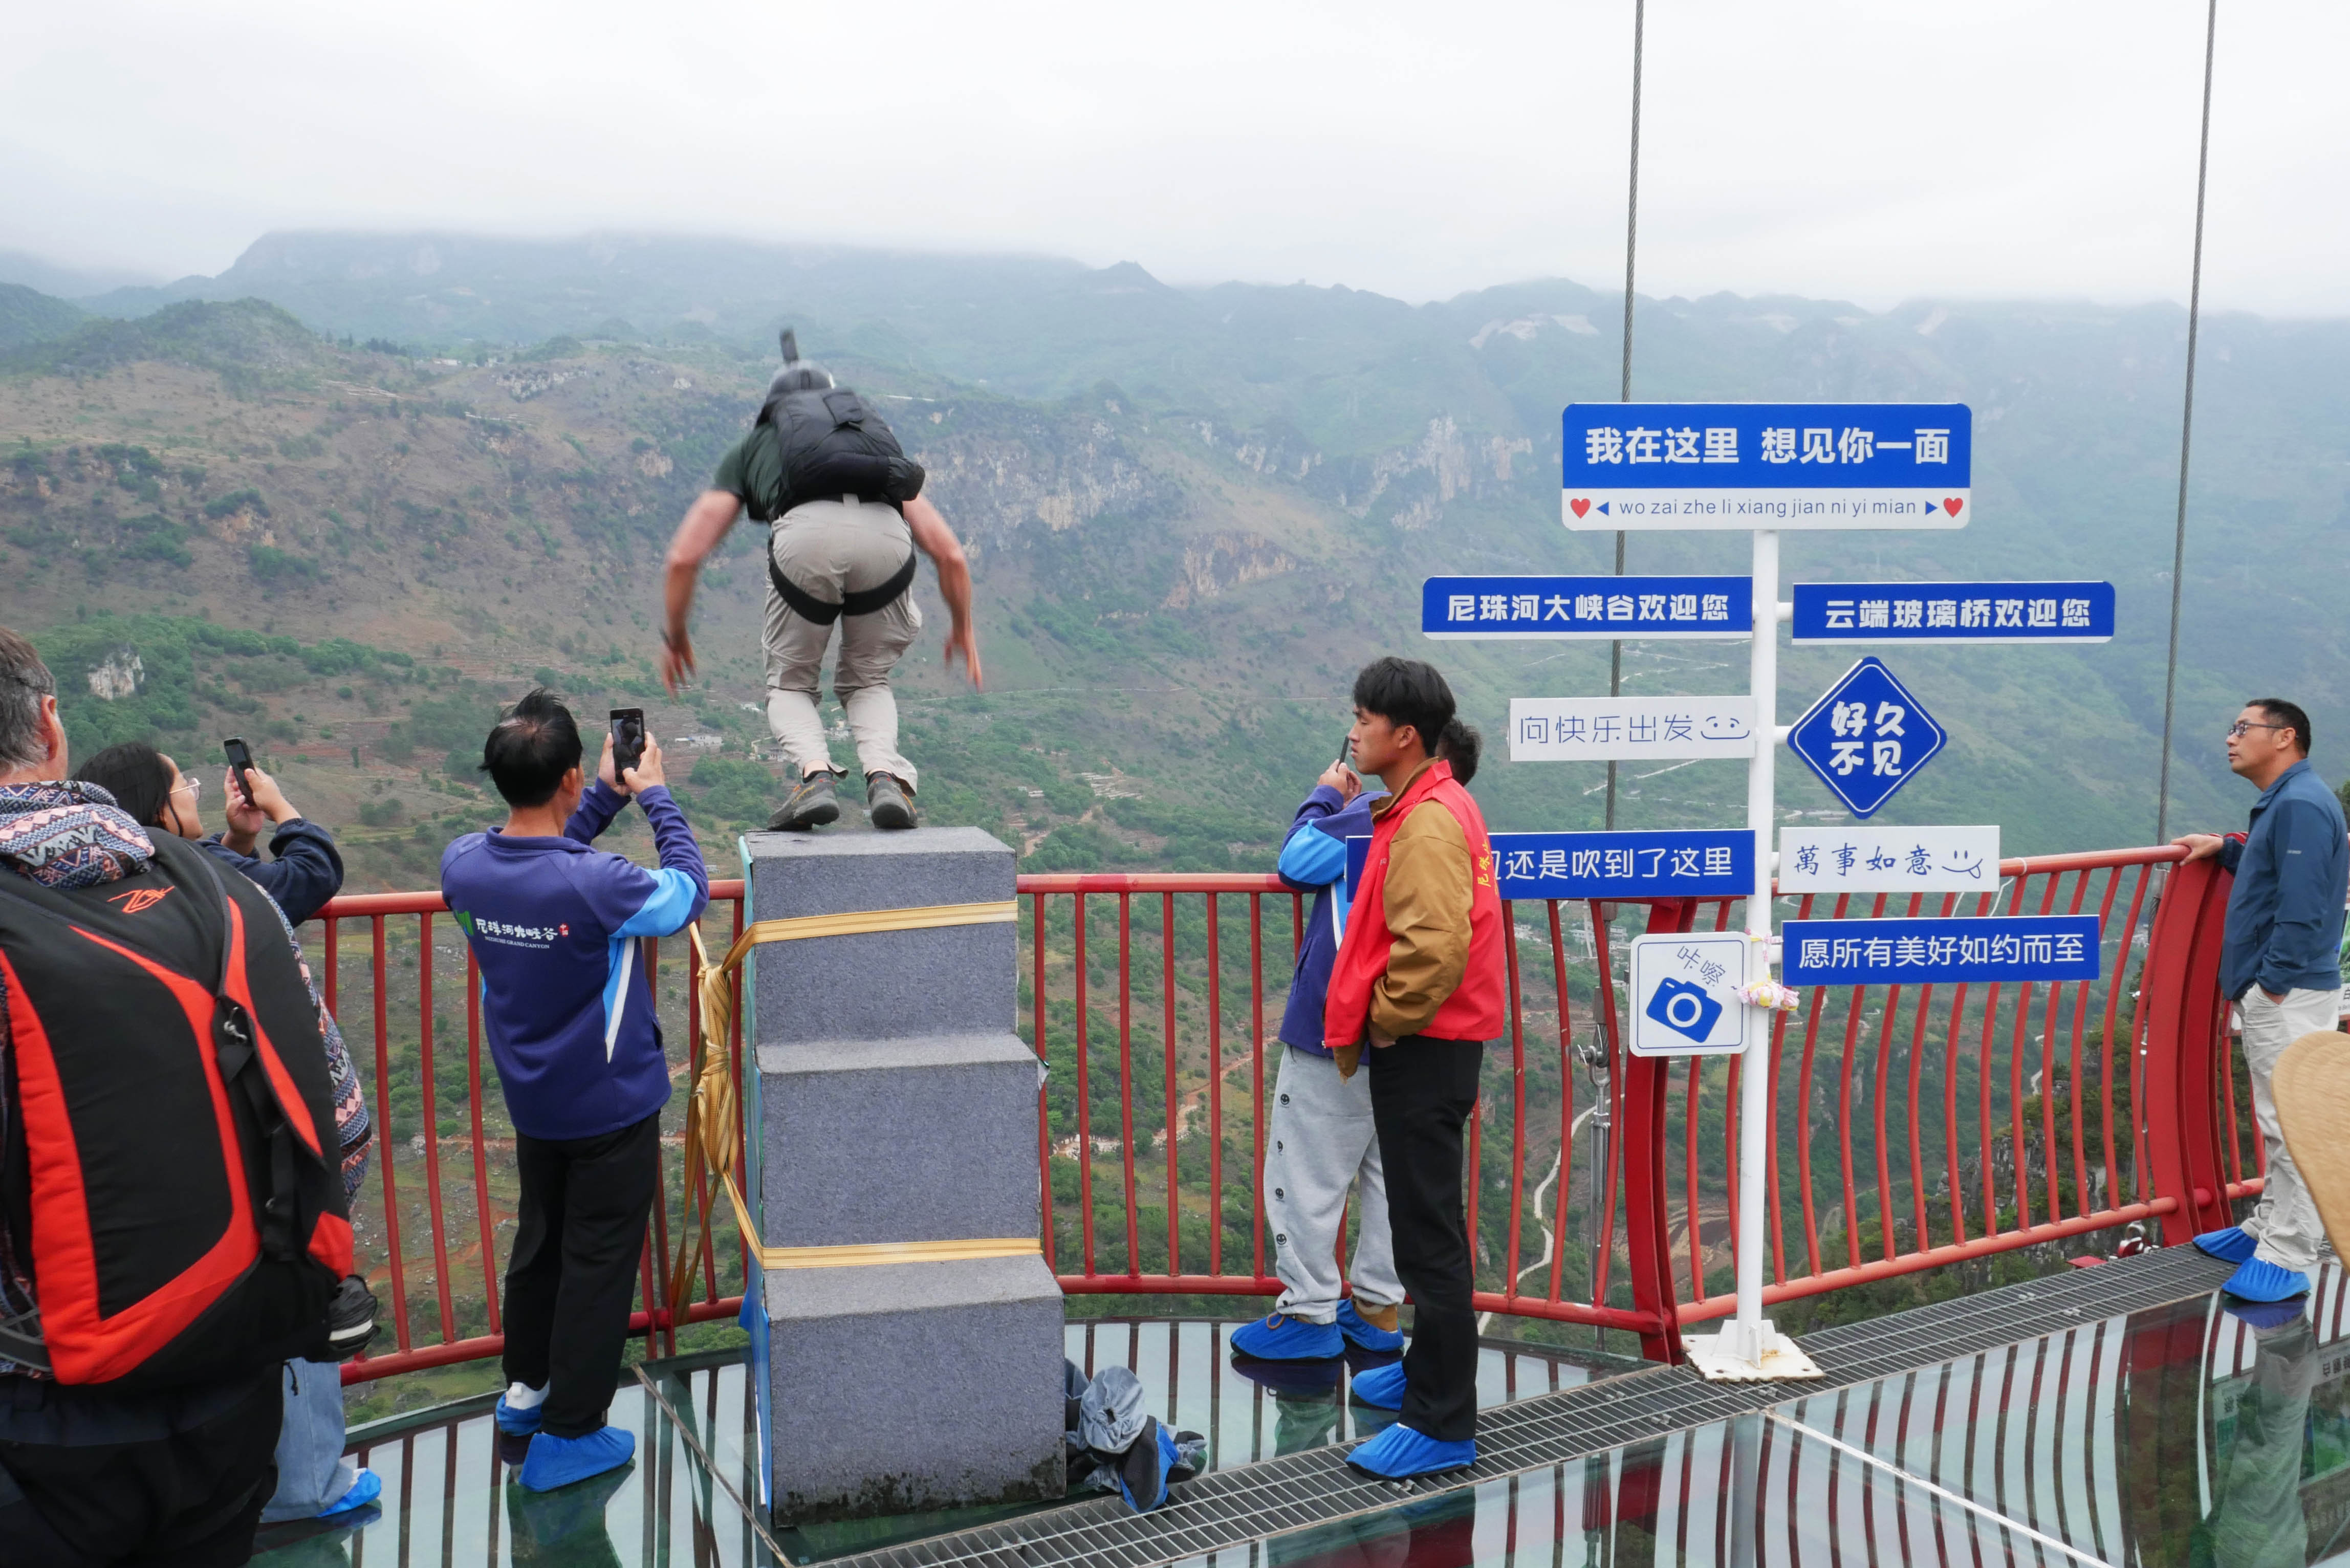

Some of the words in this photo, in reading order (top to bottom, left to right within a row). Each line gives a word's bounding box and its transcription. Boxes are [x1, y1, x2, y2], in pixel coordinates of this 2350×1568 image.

[1585, 427, 1739, 464] 我在这里
[1761, 427, 1950, 464] 想见你一面
[1620, 503, 1645, 514] wo
[1651, 499, 1677, 514] zai
[1683, 499, 1715, 514] zhe
[1723, 499, 1731, 514] li
[1737, 499, 1786, 517] xiang
[1791, 499, 1824, 517] jian
[1832, 499, 1846, 513] ni
[1852, 499, 1866, 517] yi
[1873, 499, 1916, 513] mian
[1447, 595, 1729, 622] 尼珠河大峡谷欢迎您
[1825, 599, 2090, 628] 云端玻璃桥欢迎您
[1520, 714, 1692, 744] 向快乐出发
[1831, 701, 1905, 737] 好久
[1829, 740, 1902, 776] 不见
[1794, 843, 1933, 876] 萬事如意
[475, 918, 558, 941] 尼珠河大峡谷
[1799, 934, 2084, 968] 愿所有美好如约而至
